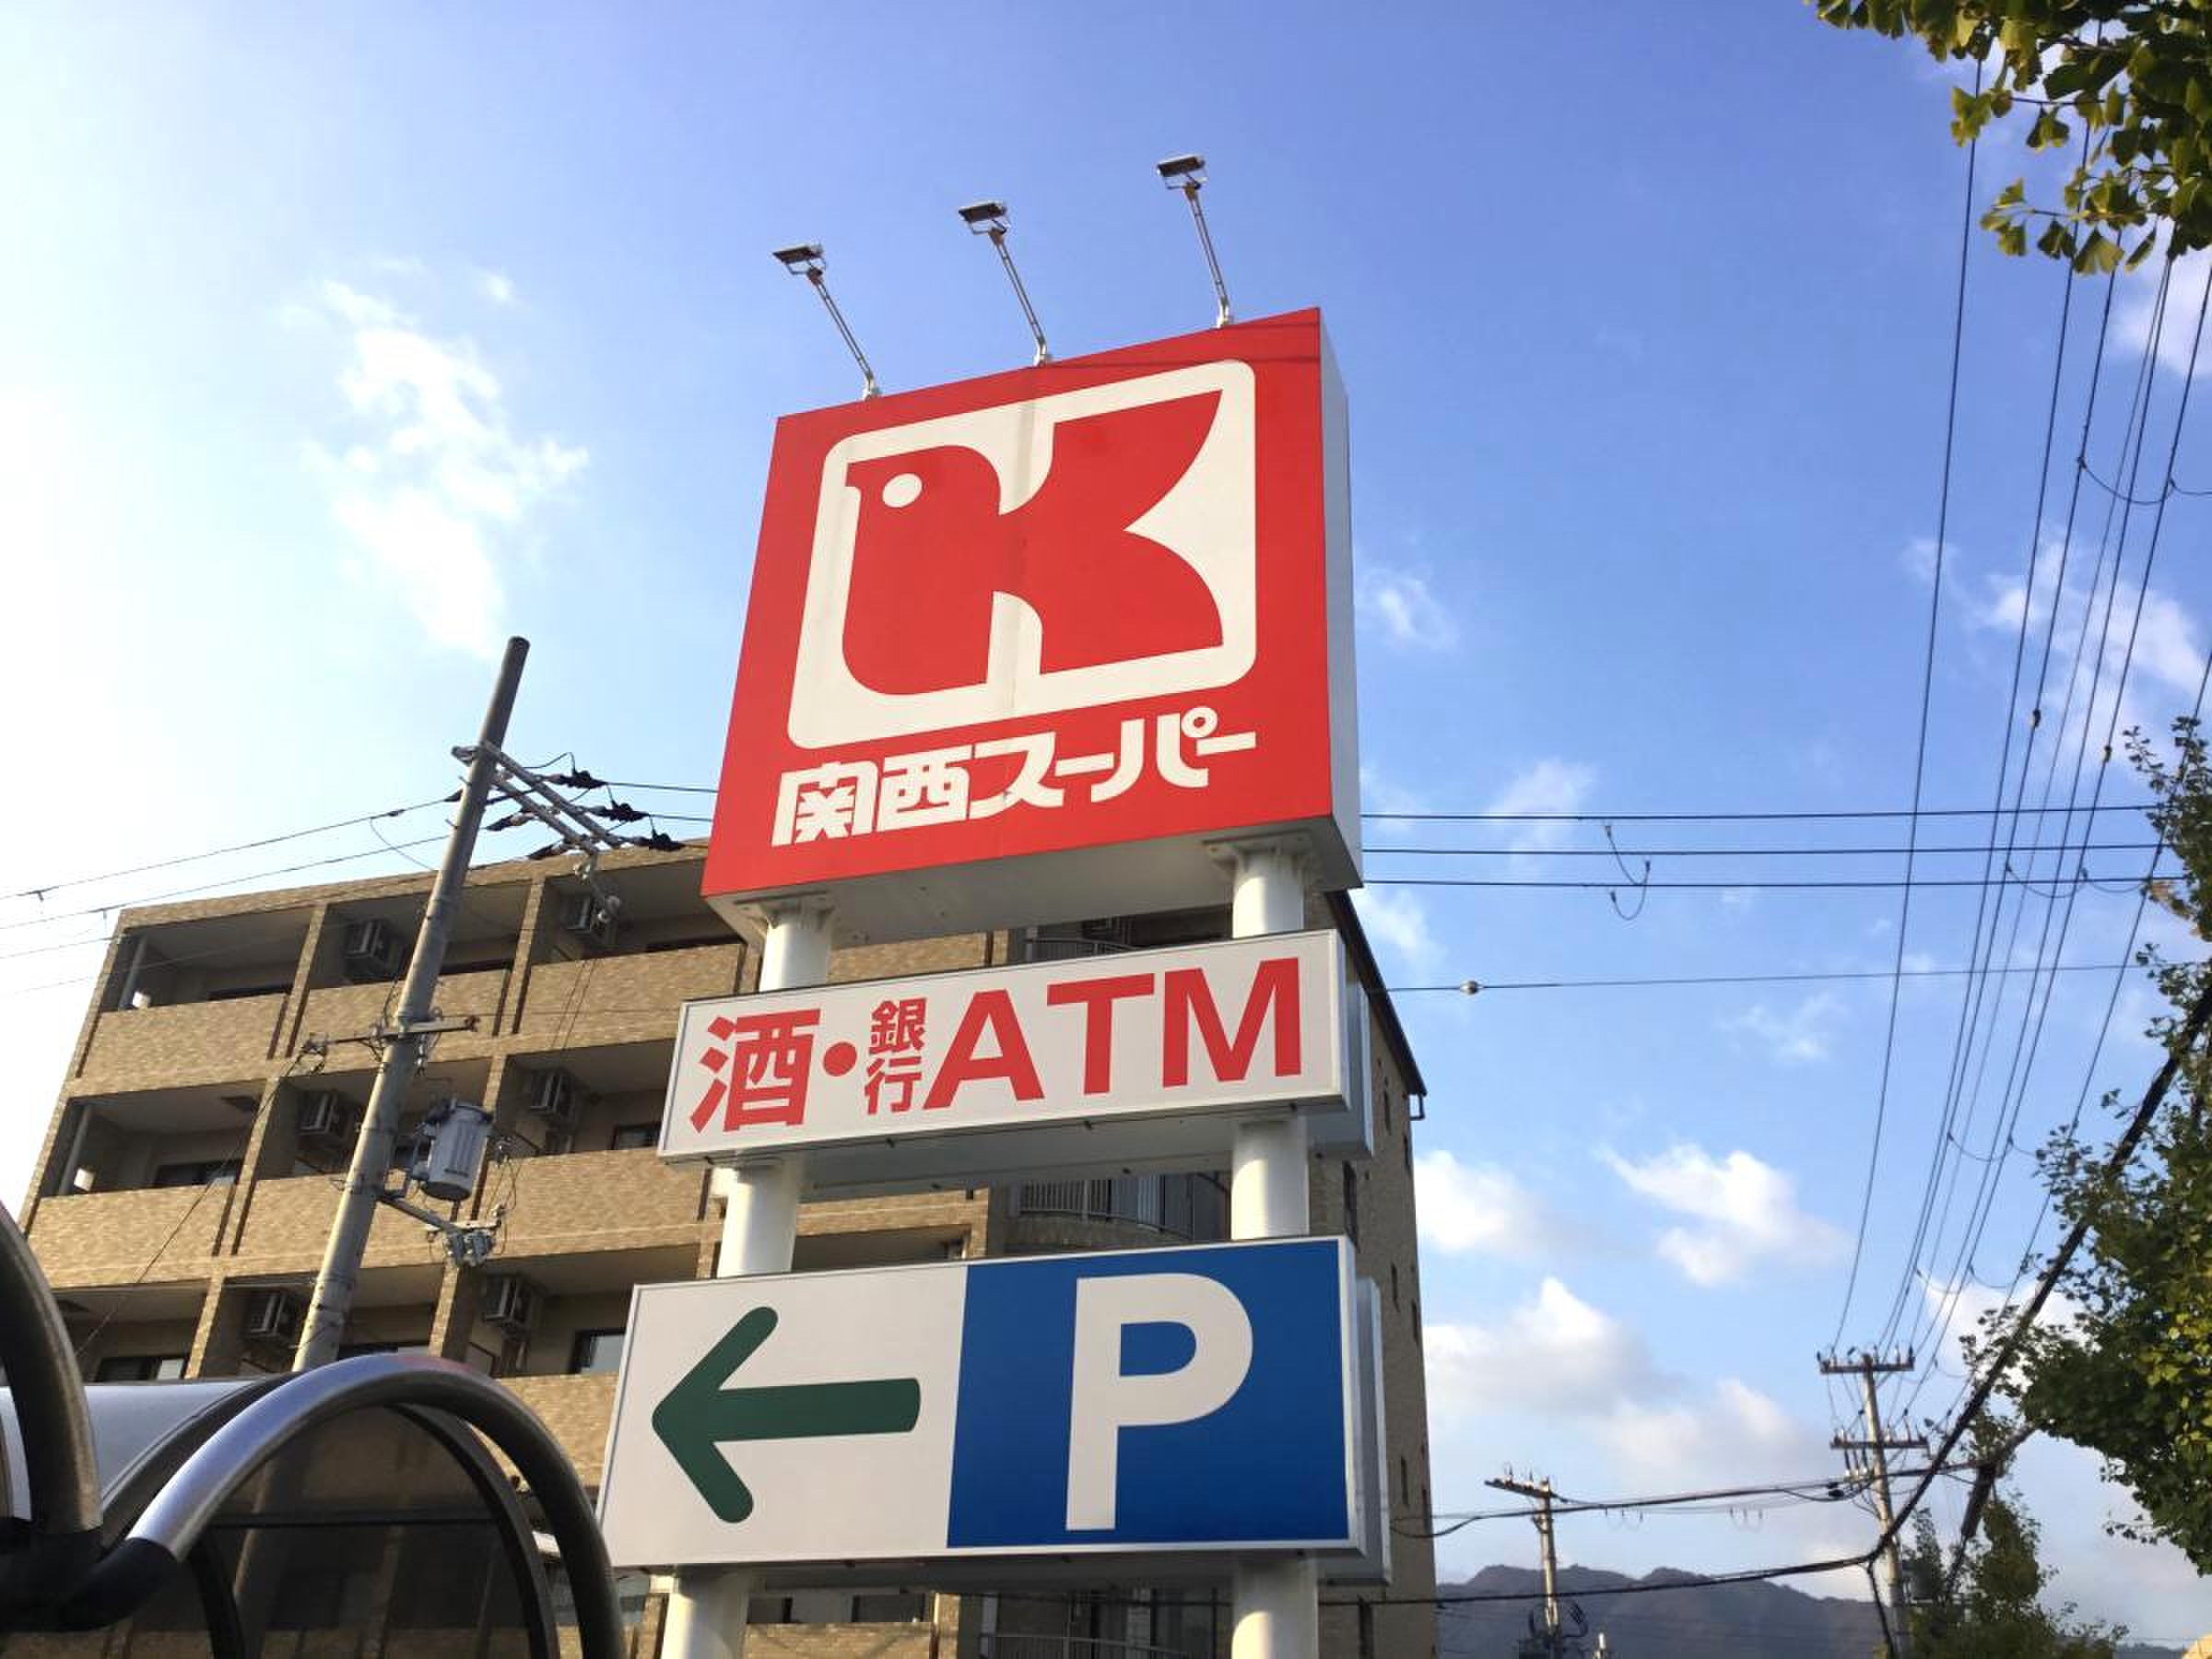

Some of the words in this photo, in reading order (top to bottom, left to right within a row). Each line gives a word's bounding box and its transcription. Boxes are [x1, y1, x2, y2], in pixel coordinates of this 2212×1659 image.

[771, 707, 1255, 846] 関西スーパー
[1066, 1273, 1253, 1530] P
